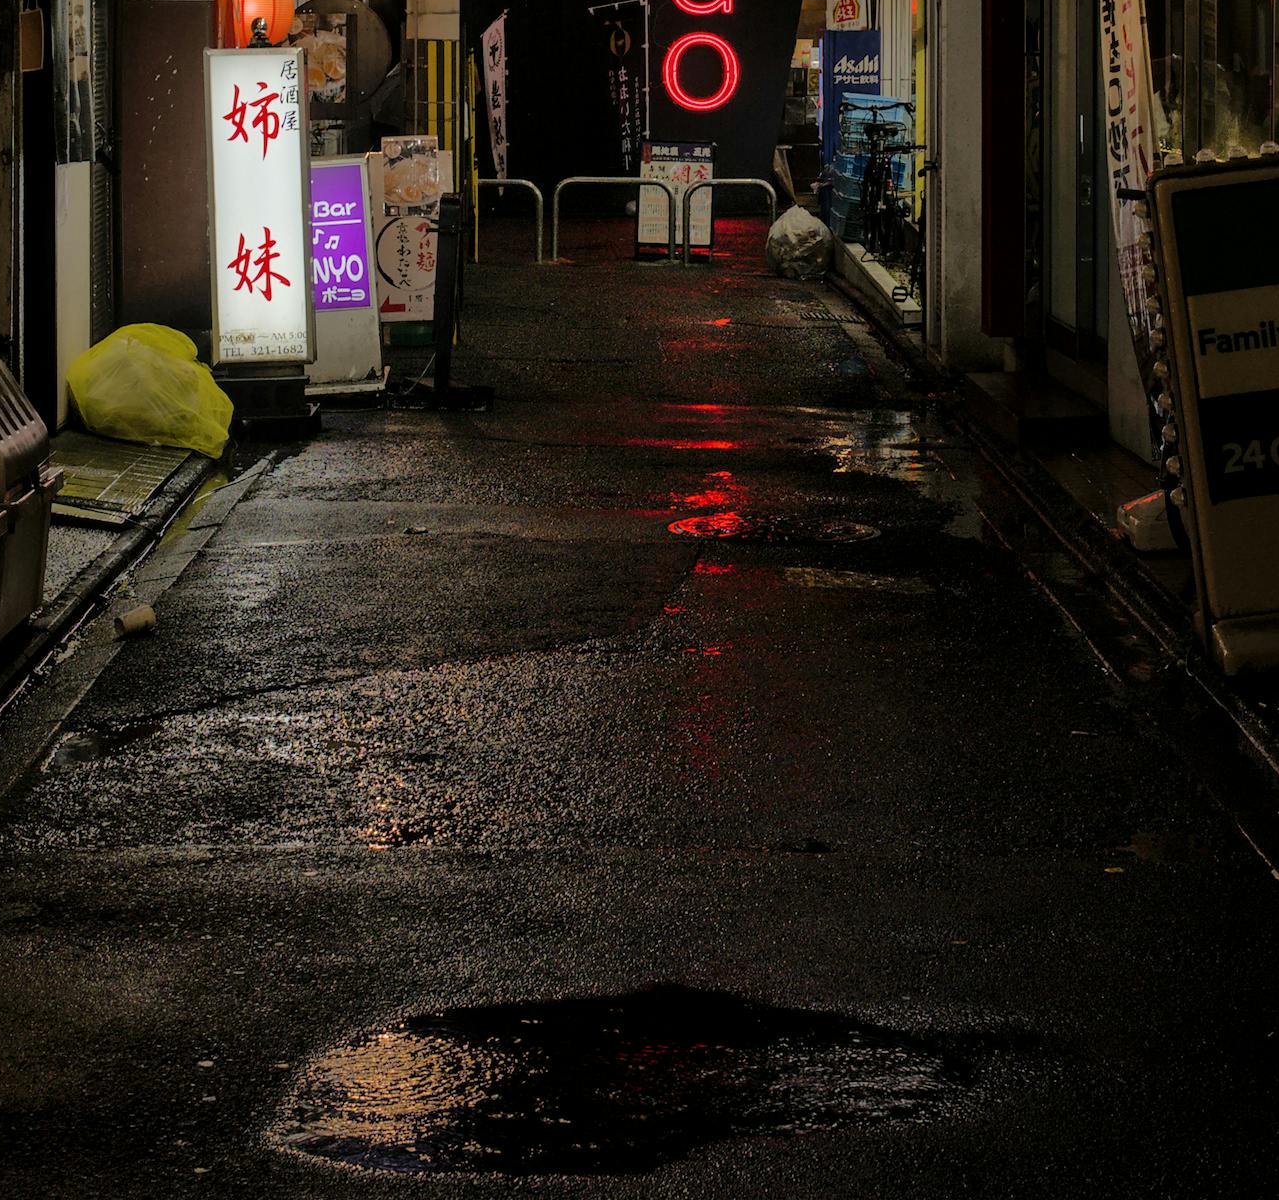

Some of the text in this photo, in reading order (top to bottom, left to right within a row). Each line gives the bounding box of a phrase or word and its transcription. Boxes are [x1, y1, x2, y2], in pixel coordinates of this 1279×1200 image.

[833, 54, 880, 74] Asahi
[279, 59, 300, 131] 居酒屋
[223, 81, 291, 302] 姉妹
[314, 201, 357, 217] Bar
[1223, 439, 1265, 475] 24
